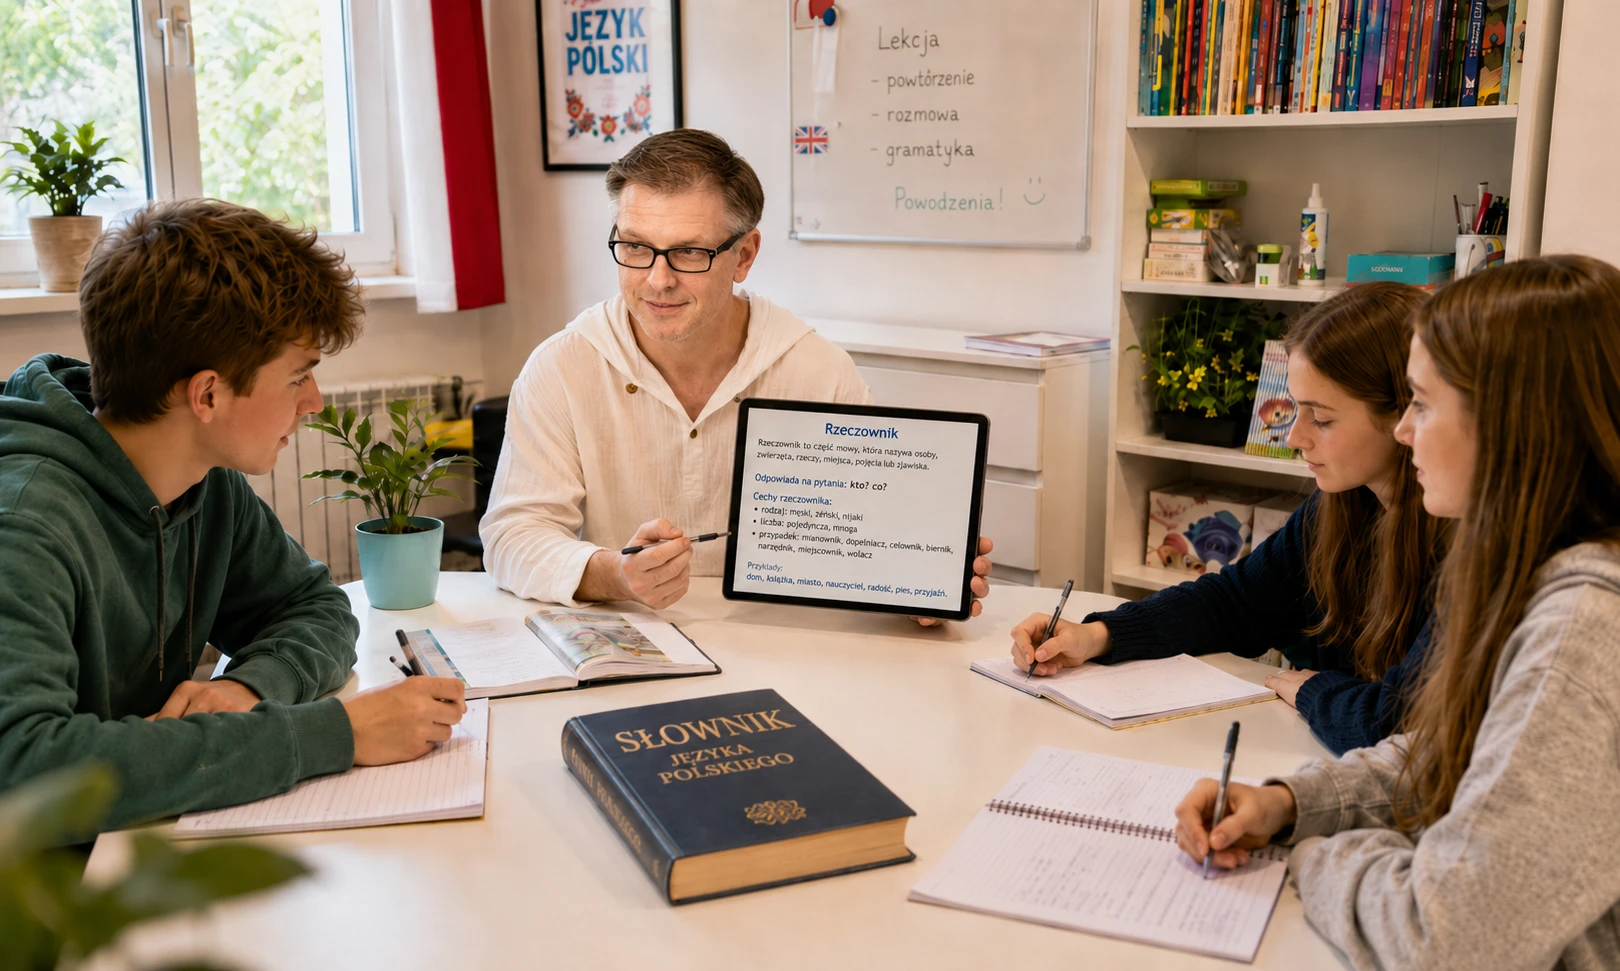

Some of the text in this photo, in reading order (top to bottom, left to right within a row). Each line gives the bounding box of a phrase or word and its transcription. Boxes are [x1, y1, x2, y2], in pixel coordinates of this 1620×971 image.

[878, 26, 940, 57] Lekcja
[887, 68, 975, 95] powtórzenie
[887, 109, 960, 122] rozmowa
[886, 139, 975, 167] gramatyka
[825, 423, 898, 439] Rzeczownik
[757, 451, 794, 461] zwierzęta,
[796, 454, 822, 463] rzeczy,
[823, 455, 853, 465] miejsca,
[884, 459, 895, 468] lub
[758, 439, 801, 449] Rzeczownik
[813, 443, 833, 452] część
[836, 445, 860, 454] mowy,
[863, 446, 882, 455] która
[885, 449, 912, 458] nazywa
[915, 450, 938, 460] osoby,
[755, 473, 887, 491] Odpowiada na pytania: kto? co?
[753, 491, 832, 505] Cechy rzeczownika:
[787, 520, 831, 531] pojedyncza,
[833, 525, 858, 534] mnoga
[842, 513, 863, 522] nijaki
[759, 531, 799, 541] przypadek:
[802, 534, 843, 545] mianownik,
[889, 541, 924, 552] celownik,
[926, 544, 954, 554] biernik,
[746, 573, 764, 582] dom,
[797, 577, 824, 587] miasto,
[825, 580, 866, 591] nauczyciel,
[868, 583, 894, 593] radość,
[895, 586, 913, 595] pies,
[615, 709, 796, 753] SŁOWNIK
[670, 743, 754, 767] JĘZYKA
[657, 753, 795, 785] POLSKIEGO
